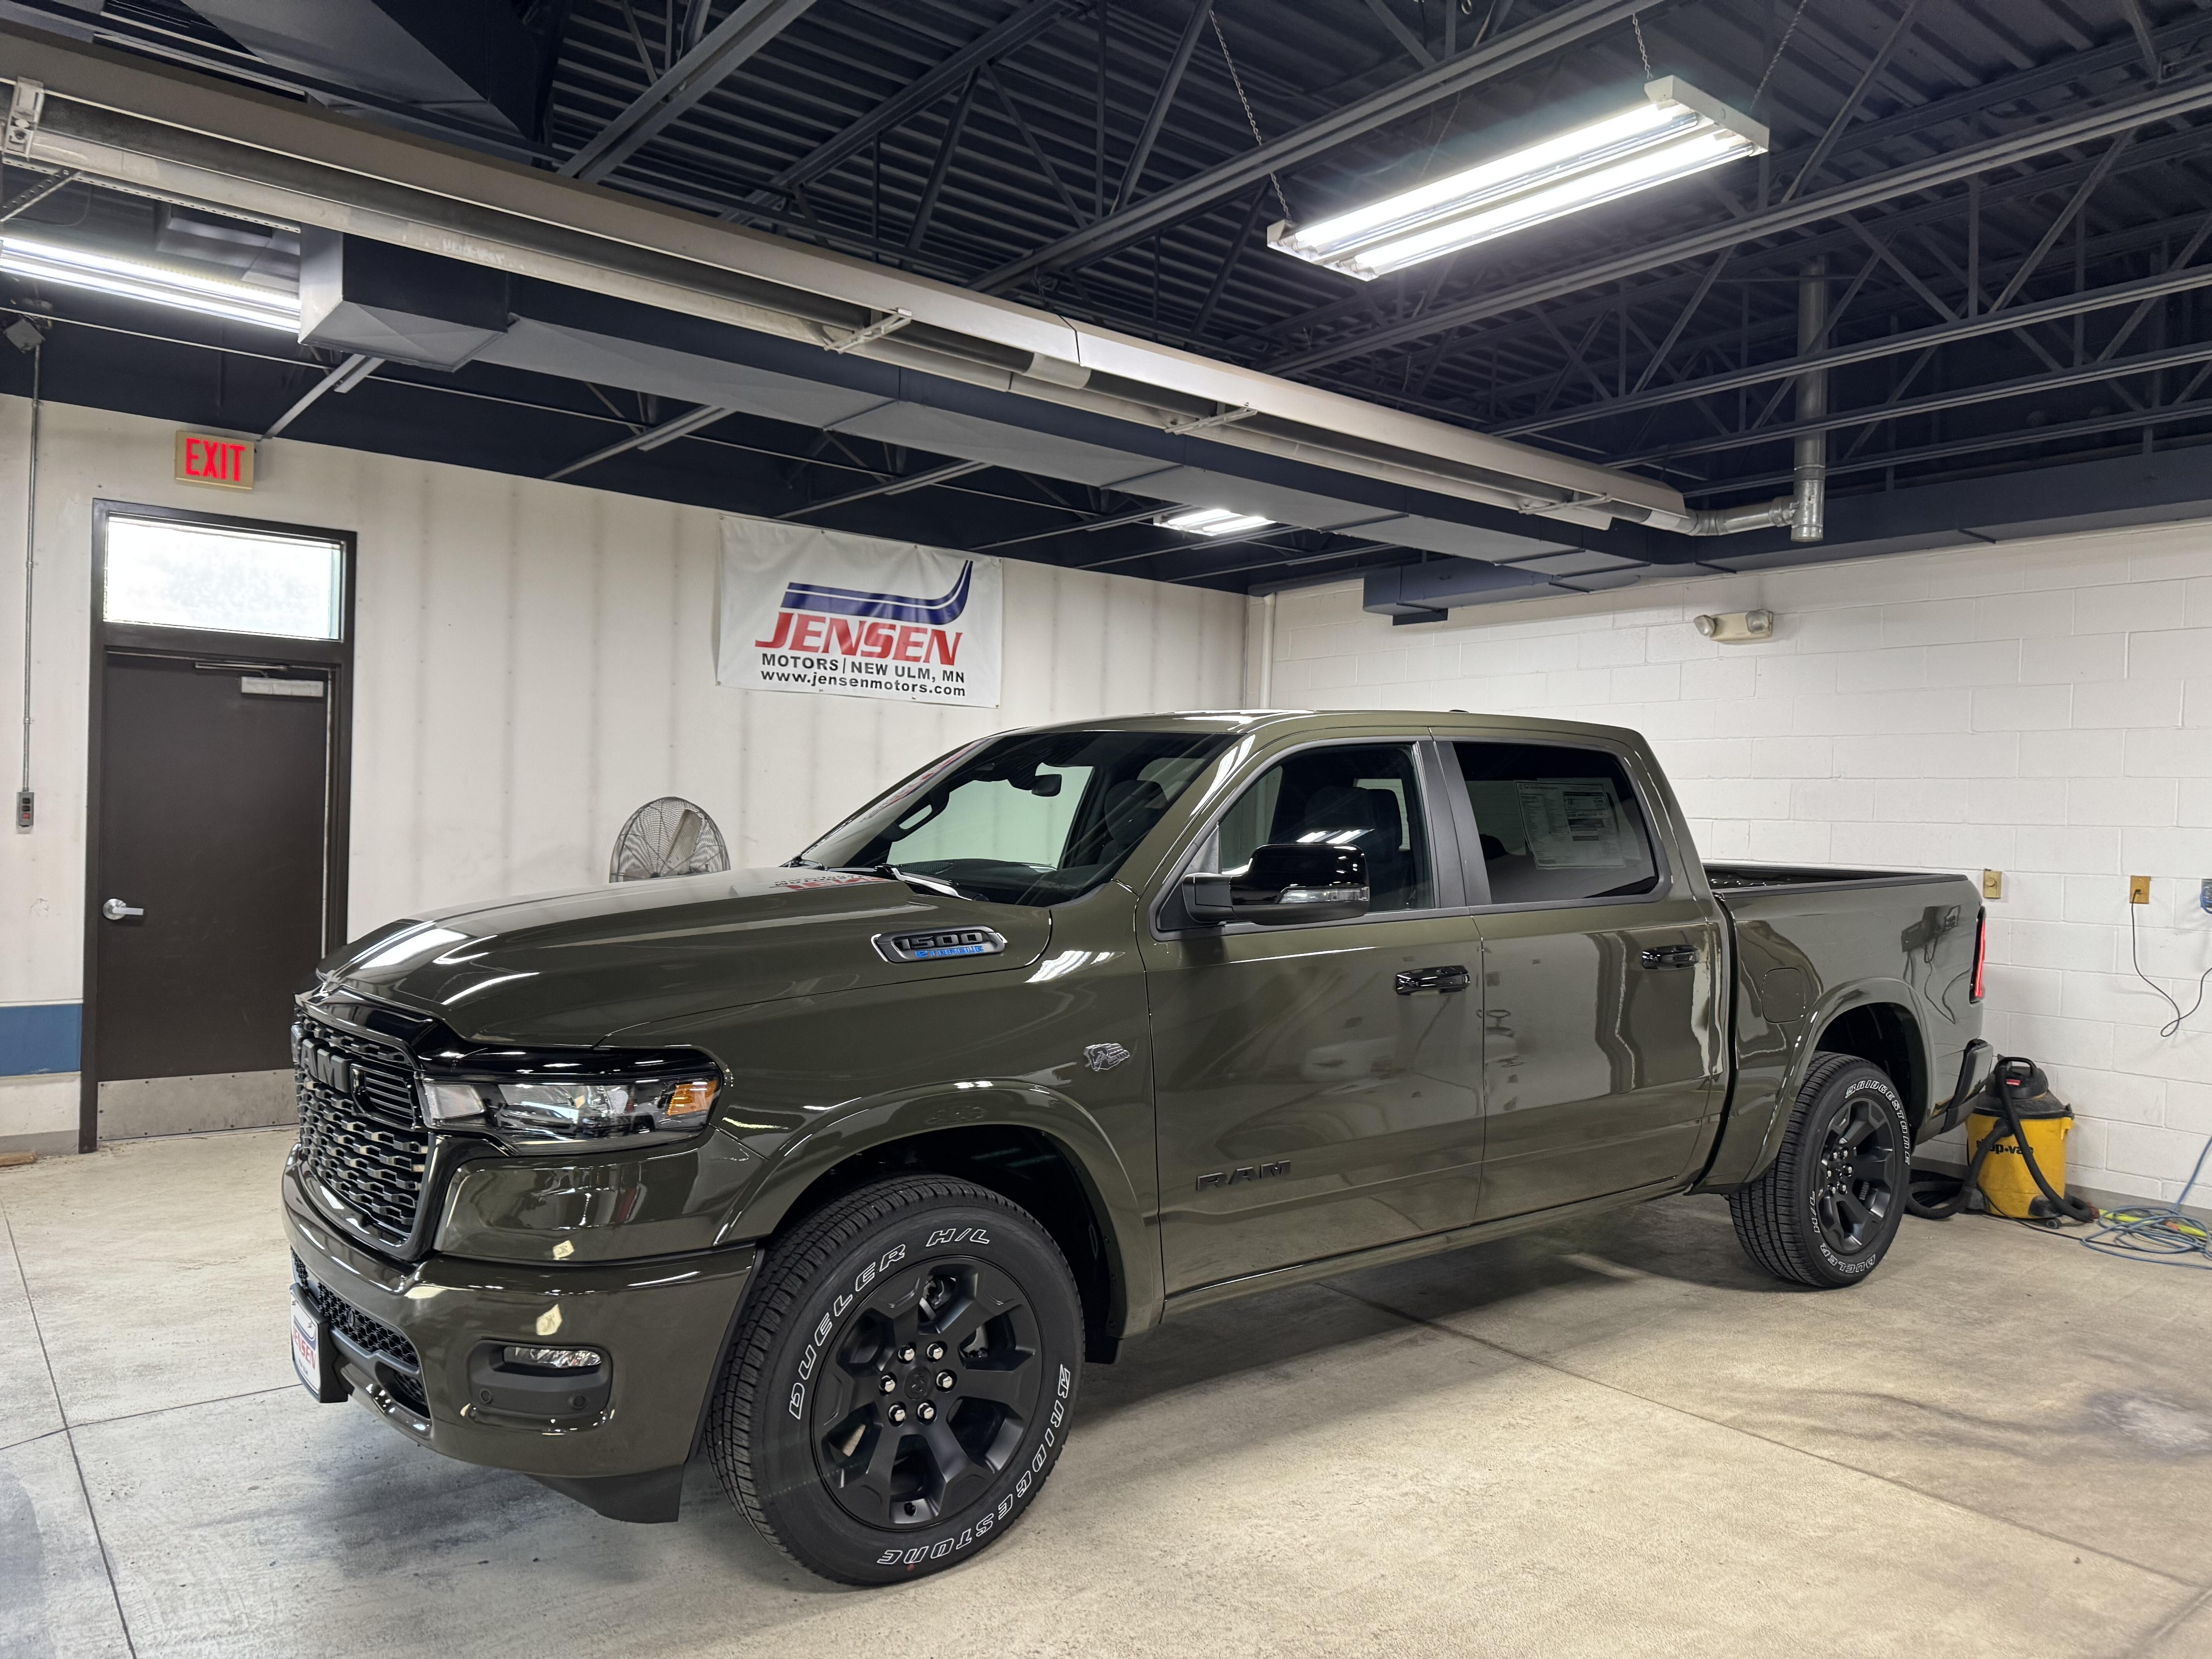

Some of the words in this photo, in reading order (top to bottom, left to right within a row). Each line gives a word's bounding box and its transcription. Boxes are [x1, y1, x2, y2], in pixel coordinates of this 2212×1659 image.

[185, 437, 246, 482] EXIT
[755, 611, 963, 666] JENSEN
[761, 670, 965, 696] www.jensenmotors.com
[762, 653, 839, 671] MOTORS
[851, 661, 888, 676] NEW
[895, 667, 936, 683] ULM,
[943, 671, 965, 683] MN
[895, 932, 983, 950] 1500
[1845, 1080, 1910, 1165] BRIDGESTONE
[1196, 1159, 1291, 1192] RAM
[1809, 1191, 1820, 1233] H/L
[1820, 1243, 1876, 1273] DUELER
[789, 1244, 906, 1419] DUELER
[926, 1228, 990, 1247] H/L
[877, 1364, 1071, 1565] BRIDGESTONE
